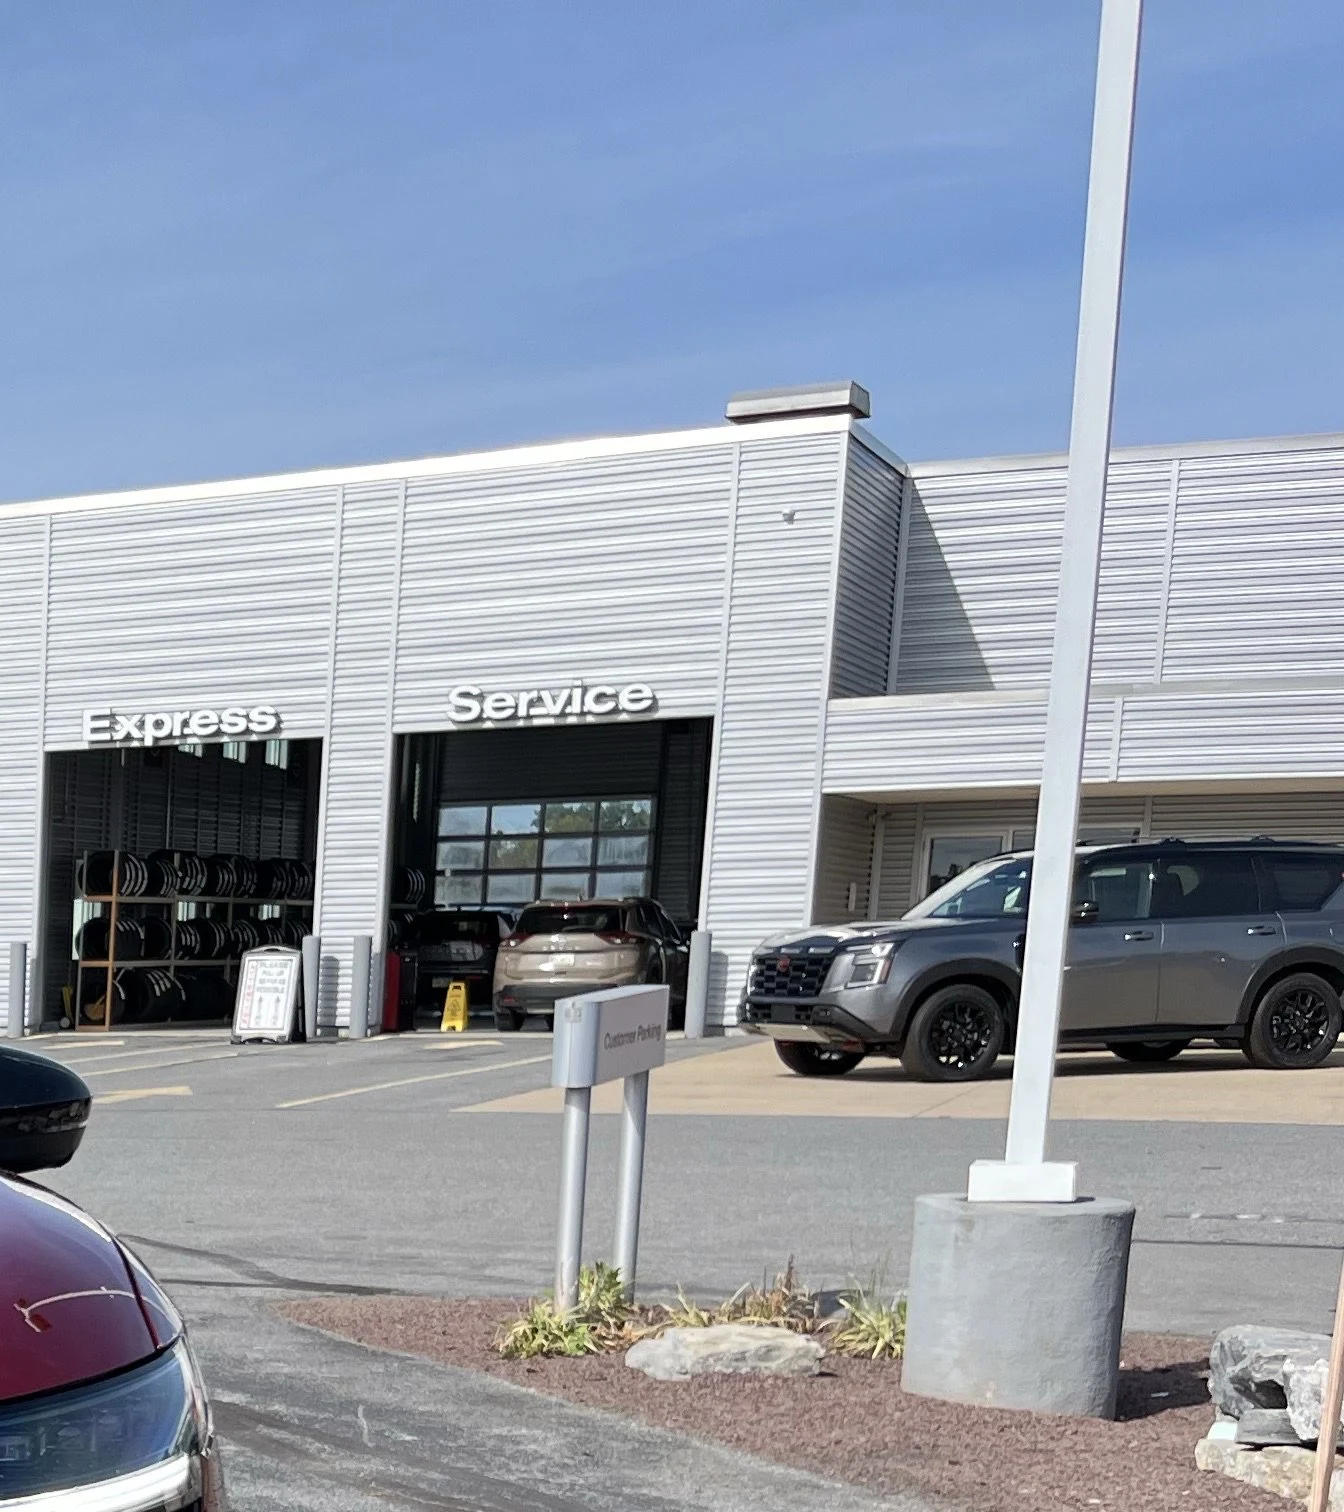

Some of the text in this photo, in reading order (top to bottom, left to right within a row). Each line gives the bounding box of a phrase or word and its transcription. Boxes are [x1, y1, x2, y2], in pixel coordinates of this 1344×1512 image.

[446, 679, 654, 722] Service
[82, 705, 278, 746] Express
[604, 1024, 661, 1050] Customer Parking
